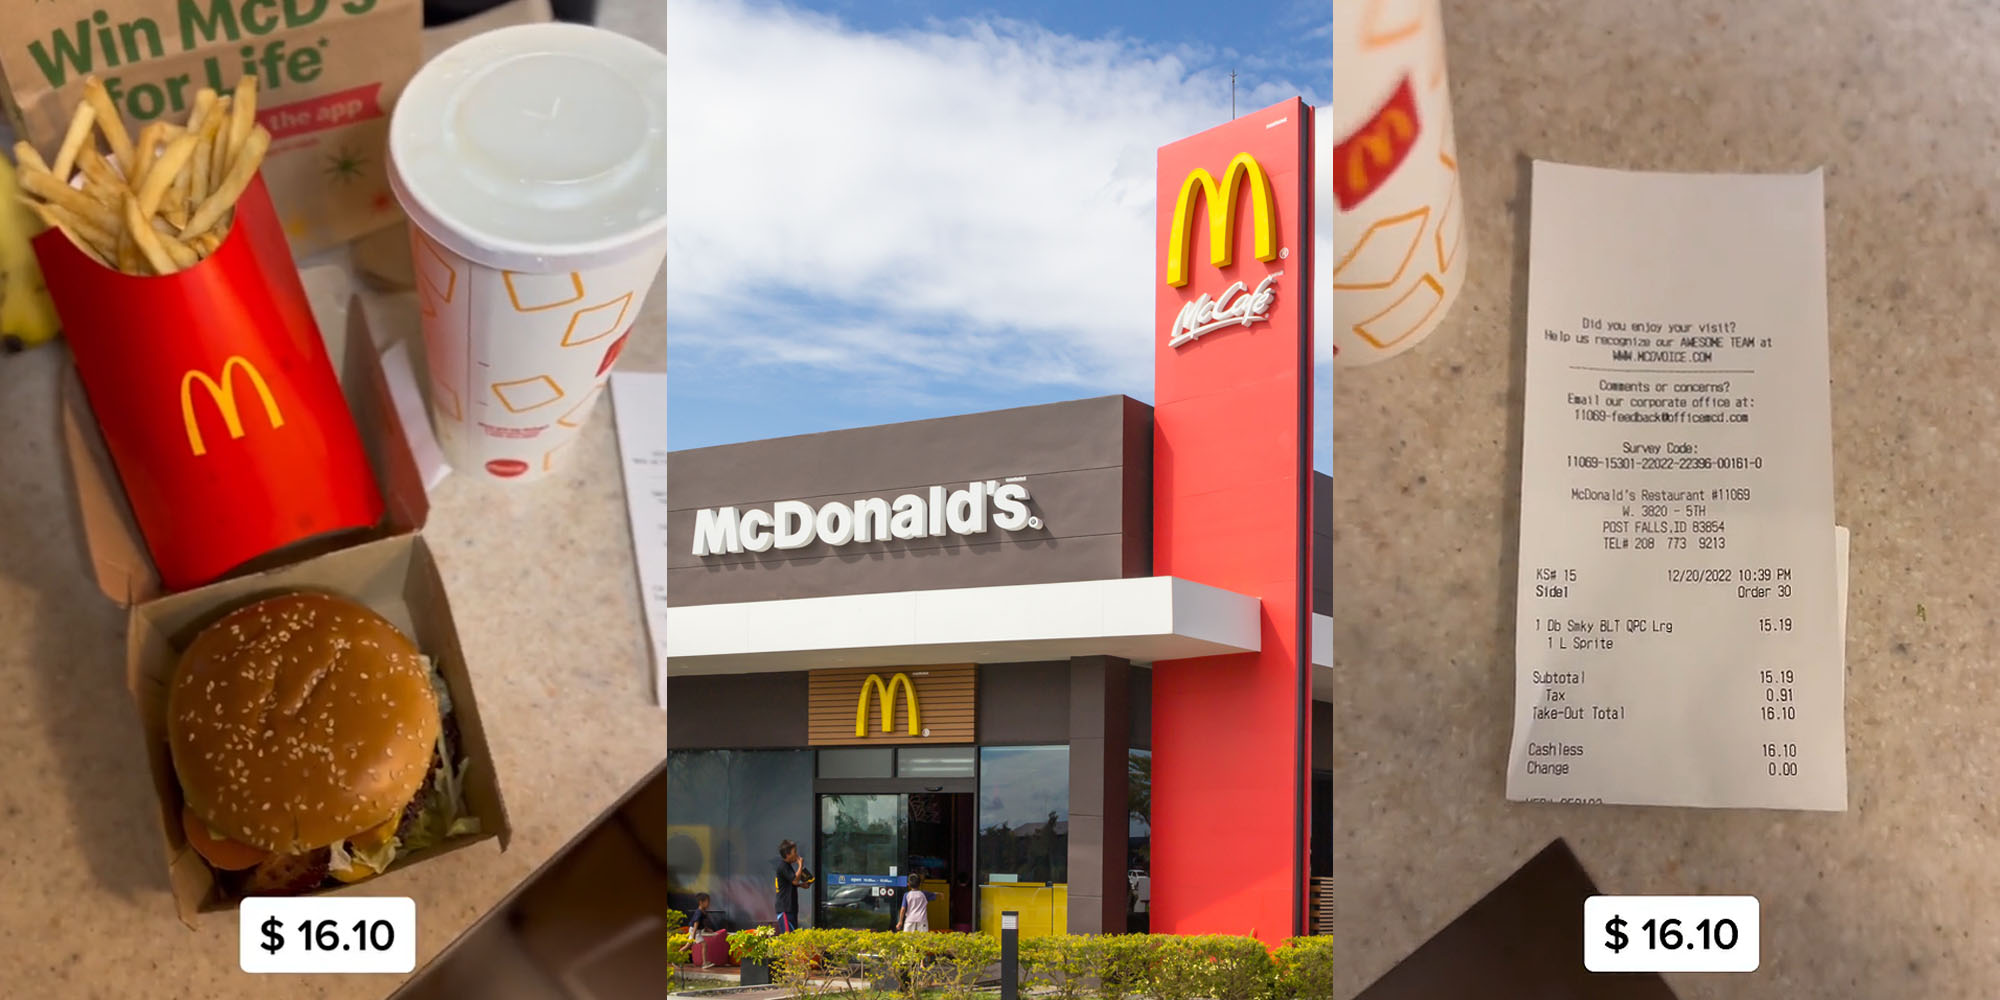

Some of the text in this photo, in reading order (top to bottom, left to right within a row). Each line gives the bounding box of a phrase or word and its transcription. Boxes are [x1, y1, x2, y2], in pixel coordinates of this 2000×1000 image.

[27, 0, 377, 89] Win McD
[104, 74, 190, 121] for
[316, 99, 363, 123] app
[1582, 317, 1736, 333] Did you enjoy your visit?
[1544, 329, 1773, 348] Help us recognize our AWESOME TEAM at
[1600, 379, 1730, 392] Comments or concerns?
[1567, 393, 1754, 408] Email our corporate office at:
[1623, 441, 1698, 454] Survey Code:
[1571, 487, 1751, 501] McDonald's Restaurant #11069
[1622, 505, 1635, 517] W.
[1642, 504, 1668, 517] 3820
[1686, 505, 1706, 517] 5TH
[692, 479, 1032, 557] McDonald's
[1602, 520, 1629, 533] POST
[1692, 520, 1725, 533] 83854
[1604, 537, 1726, 549] TEL# 208 773 9213
[1536, 568, 1791, 582] KS# 15 12/20/2022 10:39 PM
[1737, 585, 1771, 598] Order
[1778, 584, 1792, 597] 30
[1535, 618, 1792, 633] 1 Db Smky BLT QPC Lrg 15.19
[1547, 636, 1614, 650] 1 L Sprite
[1532, 670, 1794, 684] Subtotal 15.19
[1546, 688, 1793, 702] Tax 0.91
[1533, 705, 1796, 720] Take-Out Total 16.10
[1528, 742, 1797, 757] Cashless 16.10
[1526, 760, 1798, 776] Change 0.00
